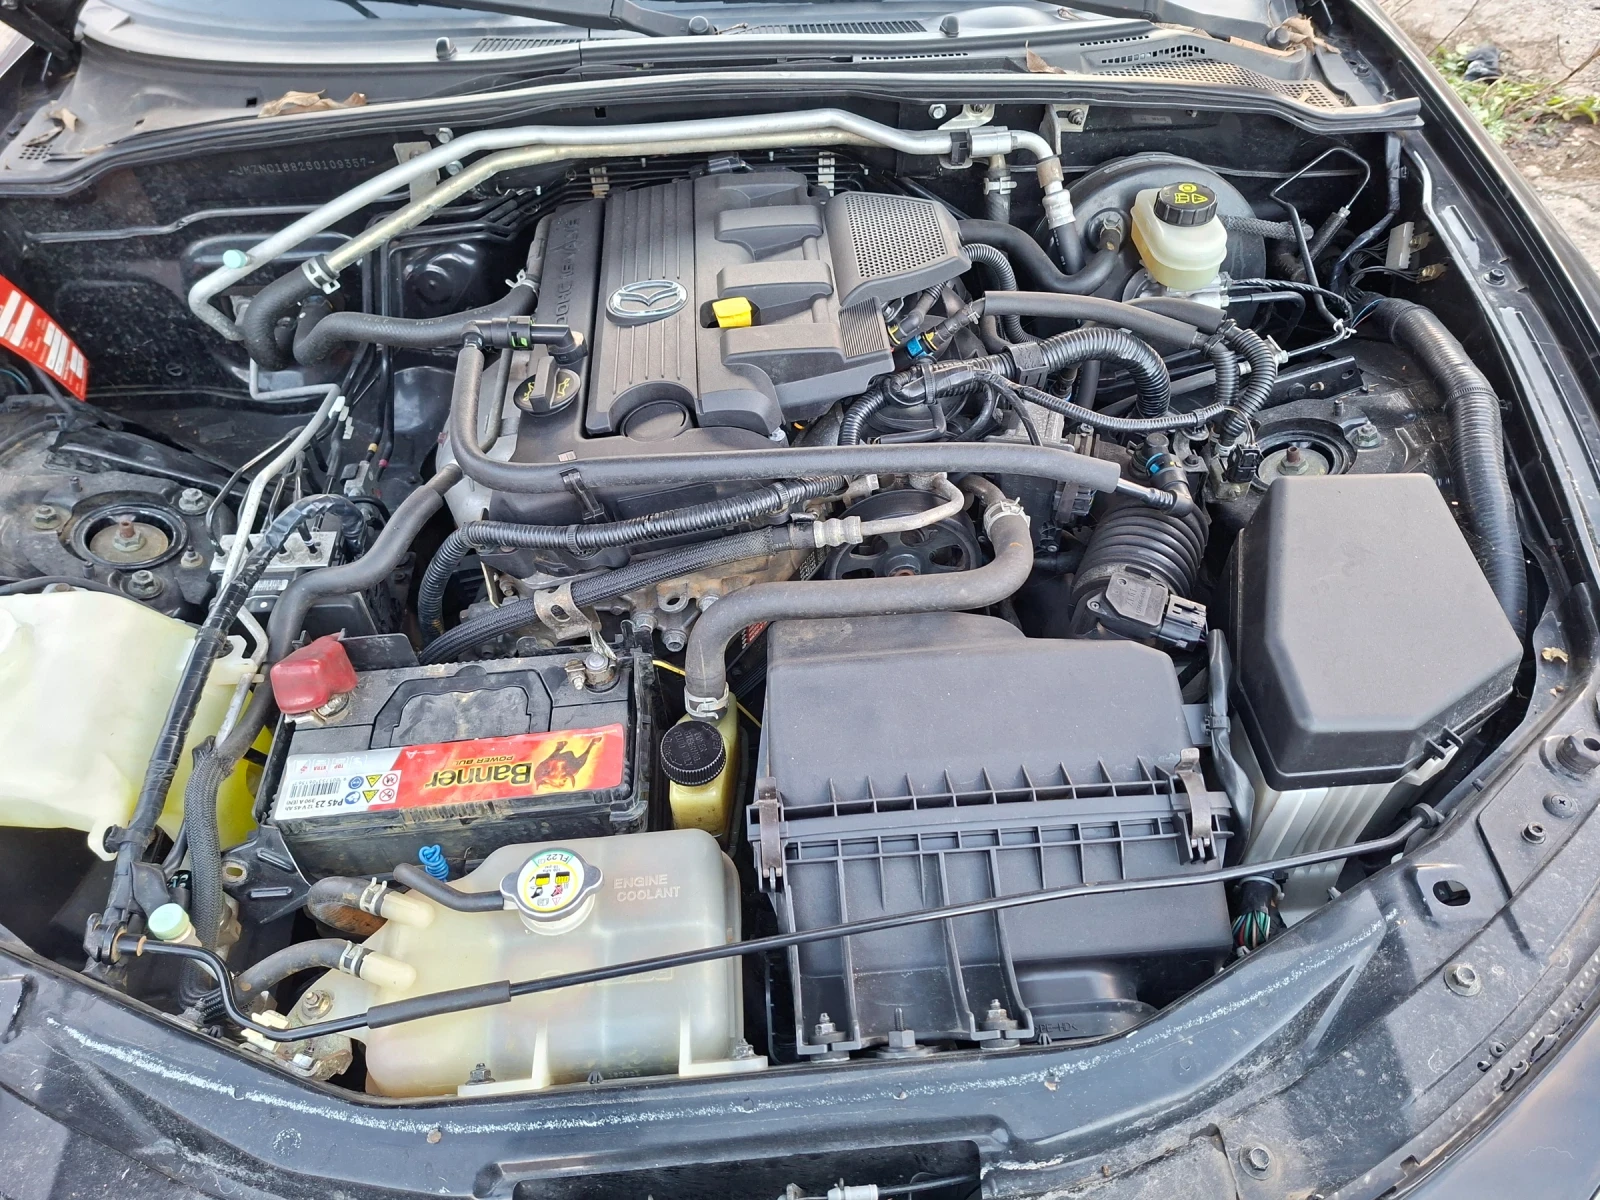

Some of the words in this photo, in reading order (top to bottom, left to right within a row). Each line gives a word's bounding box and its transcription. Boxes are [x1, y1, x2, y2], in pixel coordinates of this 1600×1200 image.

[476, 756, 514, 764] POWER
[424, 762, 533, 789] Banner
[316, 800, 326, 808] 23
[327, 798, 344, 807] P45
[546, 853, 570, 863] FL22
[613, 873, 668, 890] ENGINE
[616, 885, 681, 903] COOLANT
